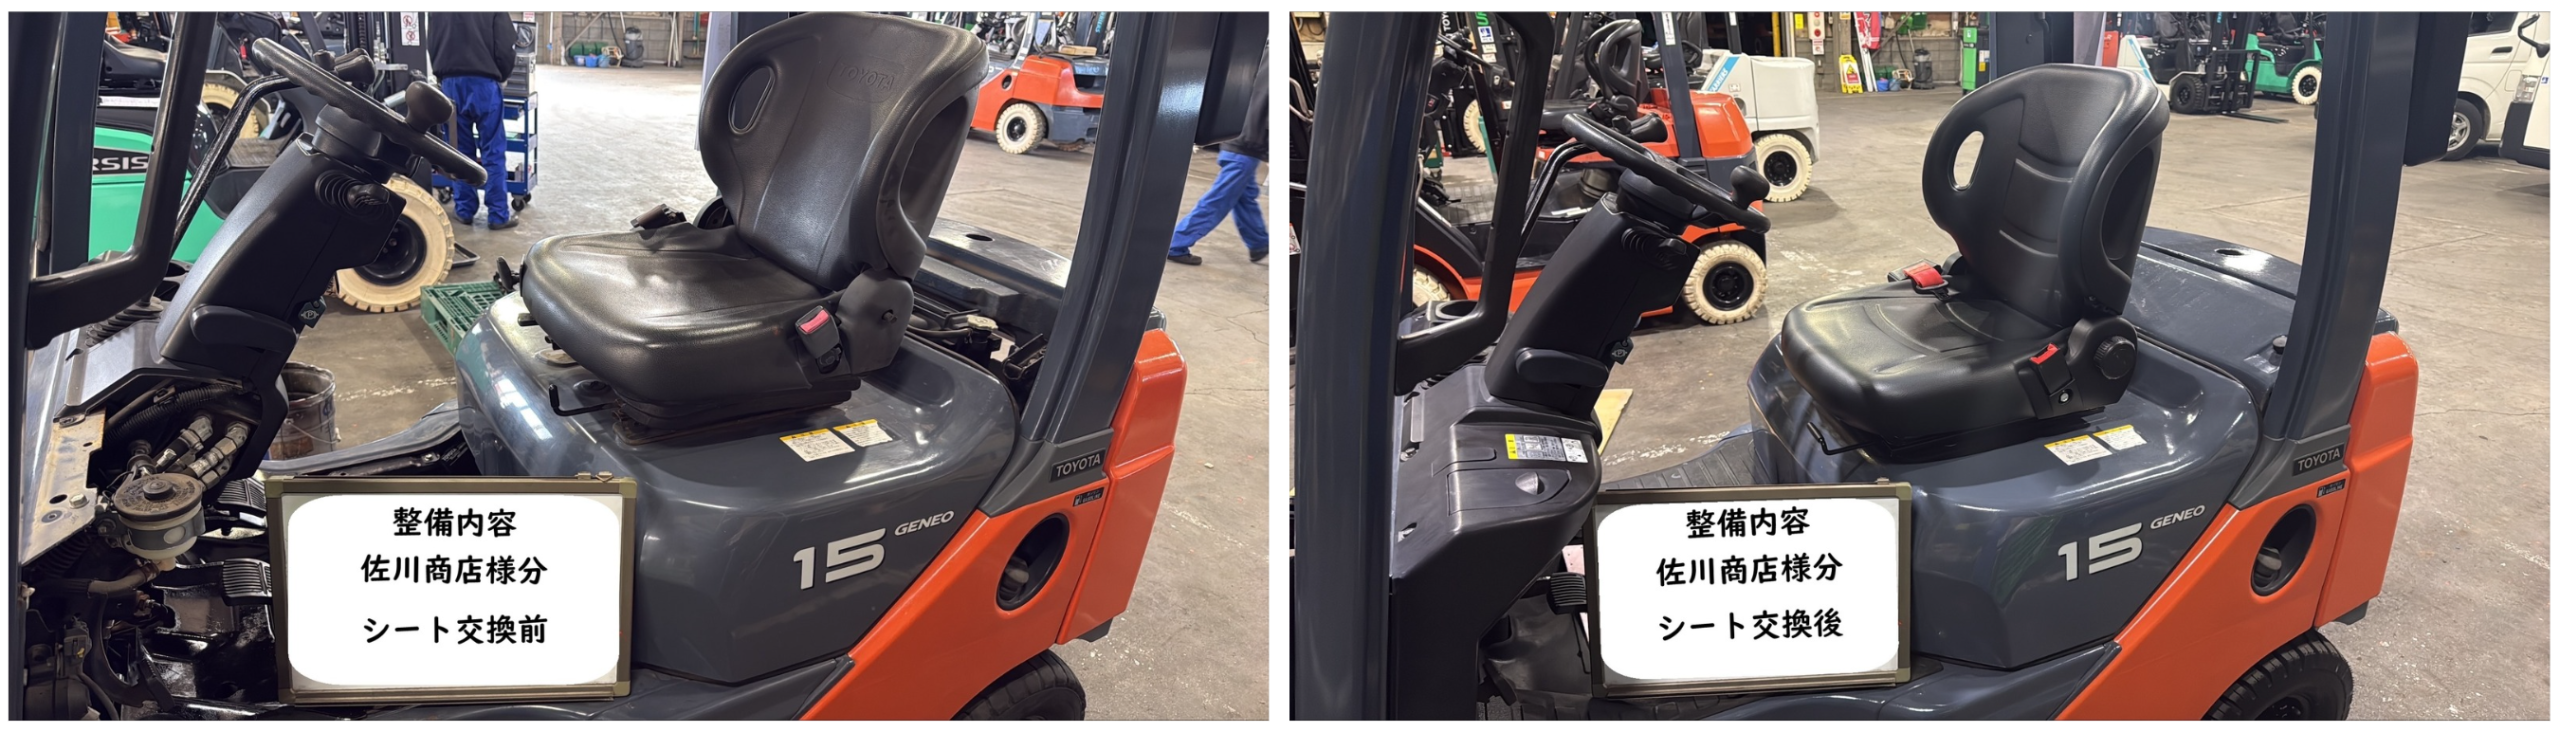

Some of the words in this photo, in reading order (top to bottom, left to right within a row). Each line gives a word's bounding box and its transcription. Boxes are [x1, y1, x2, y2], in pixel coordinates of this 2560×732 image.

[839, 63, 895, 90] TOYOTA
[1056, 453, 1101, 477] TOYOTA
[2298, 448, 2340, 471] TOYOTA
[894, 510, 955, 536] GENEO
[2150, 505, 2205, 529] GENEO
[793, 527, 886, 590] 15
[2058, 522, 2142, 581] 15
